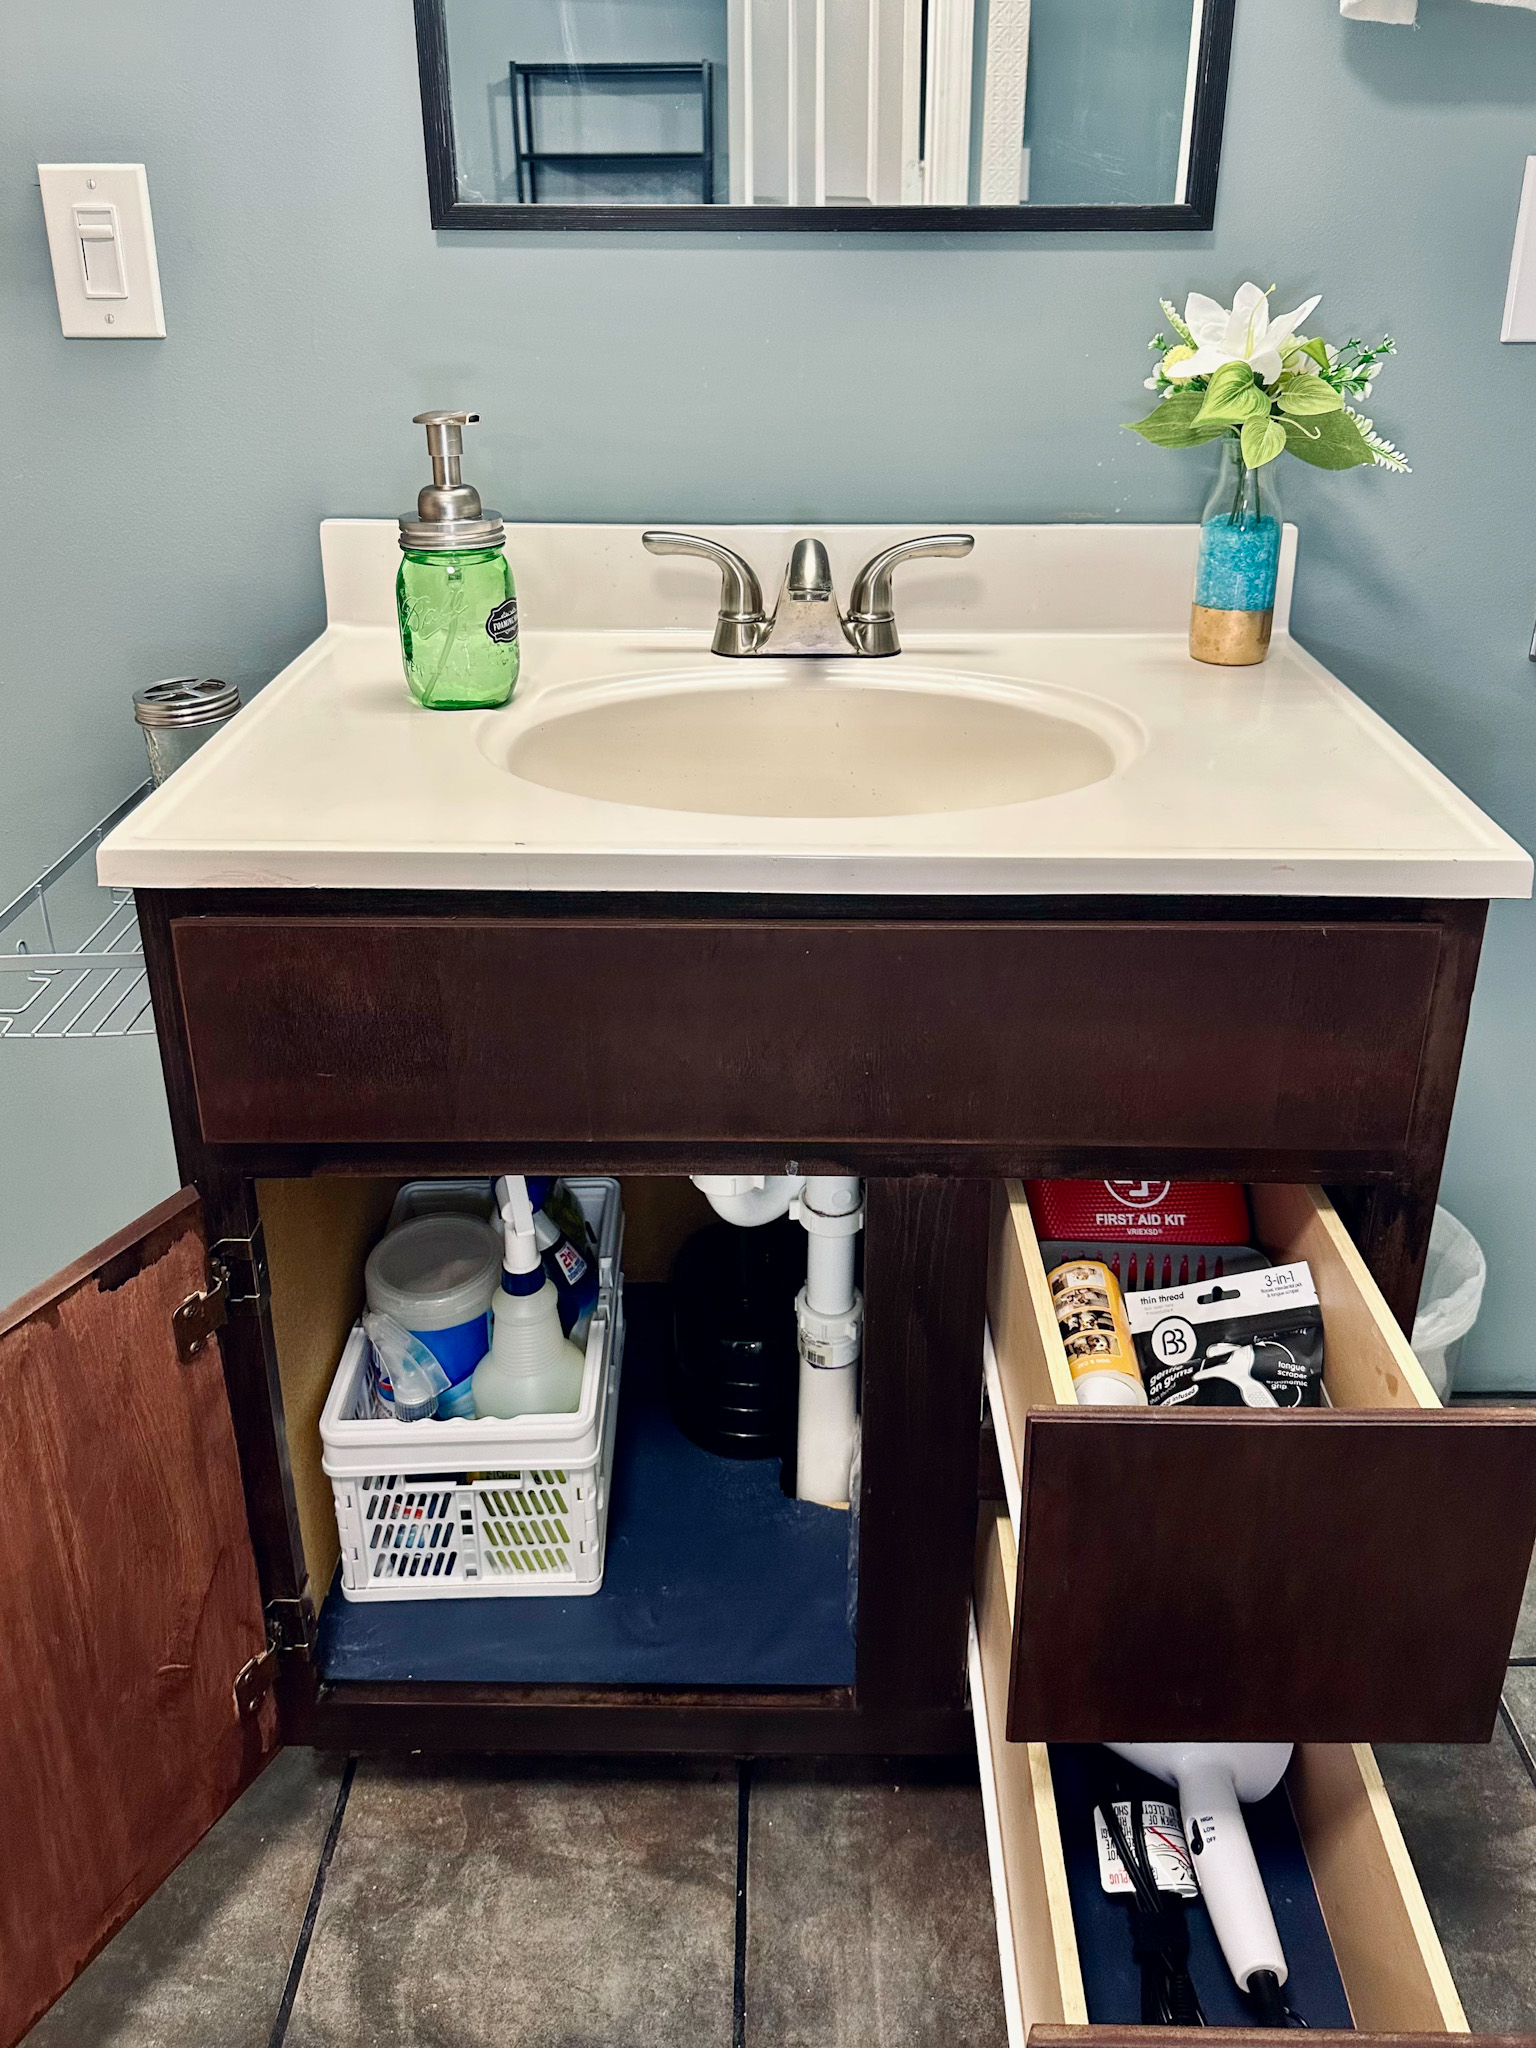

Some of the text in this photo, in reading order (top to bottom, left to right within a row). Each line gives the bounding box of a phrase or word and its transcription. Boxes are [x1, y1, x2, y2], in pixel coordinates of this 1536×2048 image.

[1095, 1213, 1187, 1226] FIRST AID KIT
[1264, 1270, 1295, 1287] 3-in-1
[1140, 1292, 1185, 1305] thin thread
[1277, 1360, 1306, 1372] tongue
[1277, 1369, 1308, 1380] scraper
[1150, 1367, 1194, 1395] on gums
[1270, 1383, 1288, 1391] grip
[1203, 1826, 1215, 1834] LOW
[1206, 1835, 1216, 1844] OFF
[1109, 1873, 1129, 1885] PLUG
